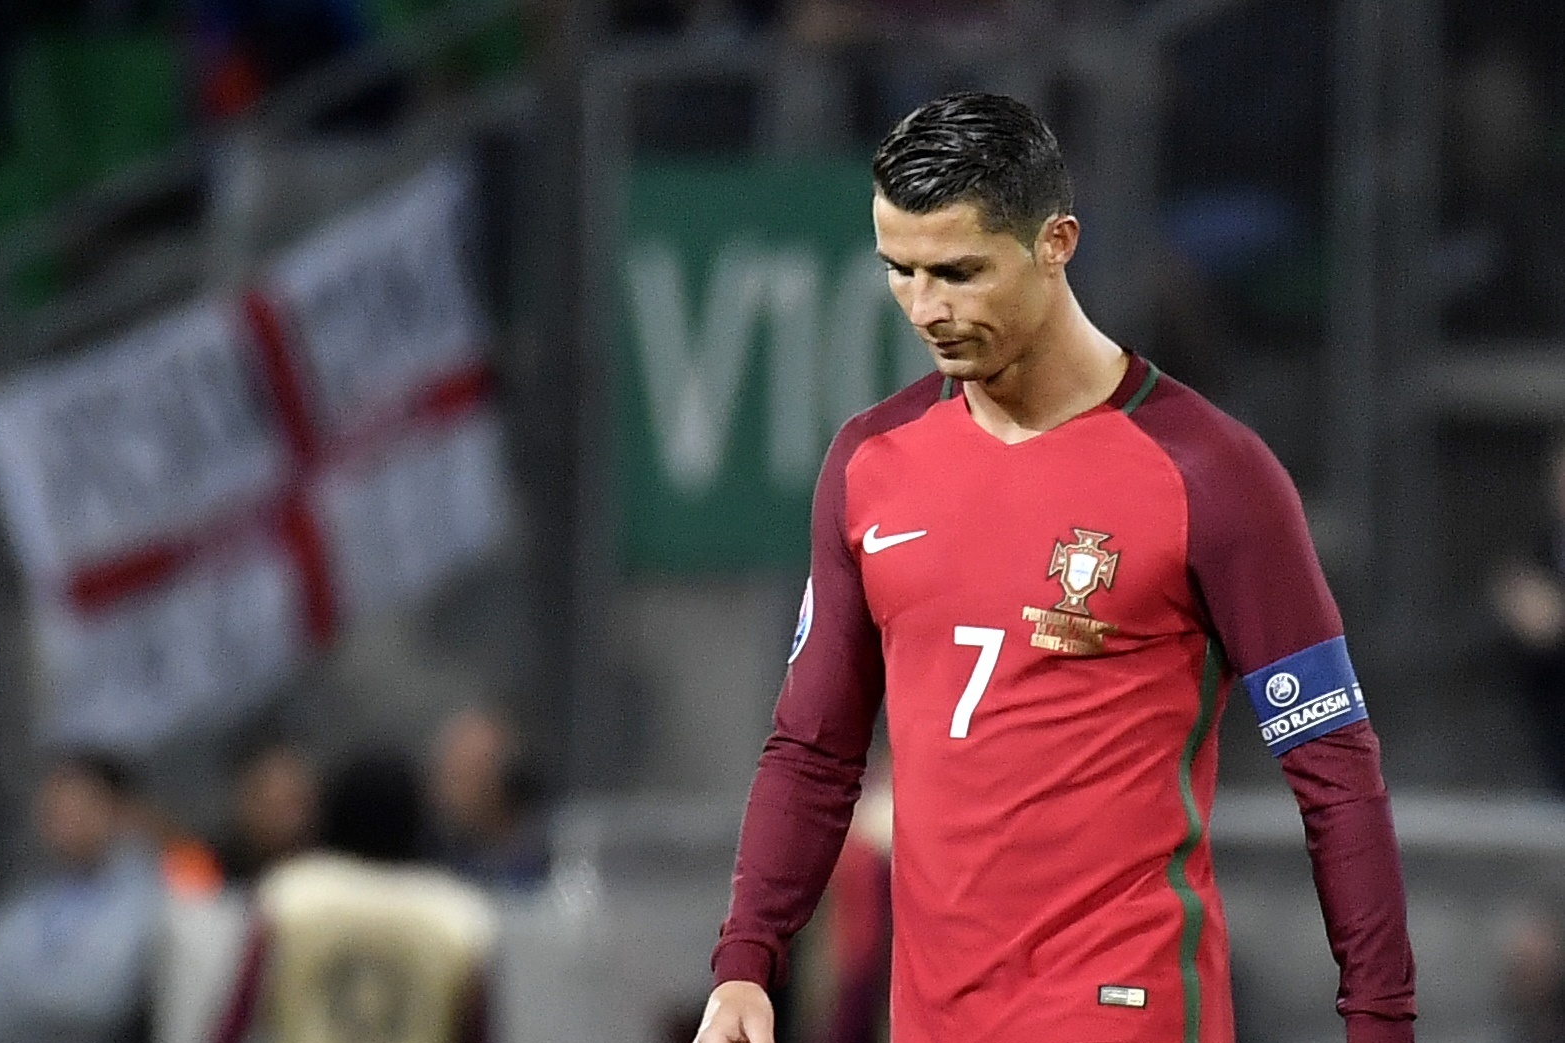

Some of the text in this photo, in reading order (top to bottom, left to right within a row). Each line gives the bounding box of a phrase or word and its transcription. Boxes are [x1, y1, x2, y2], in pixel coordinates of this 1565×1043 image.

[949, 625, 1006, 738] 7
[1269, 719, 1290, 737] TO
[1290, 692, 1350, 728] RACISM
